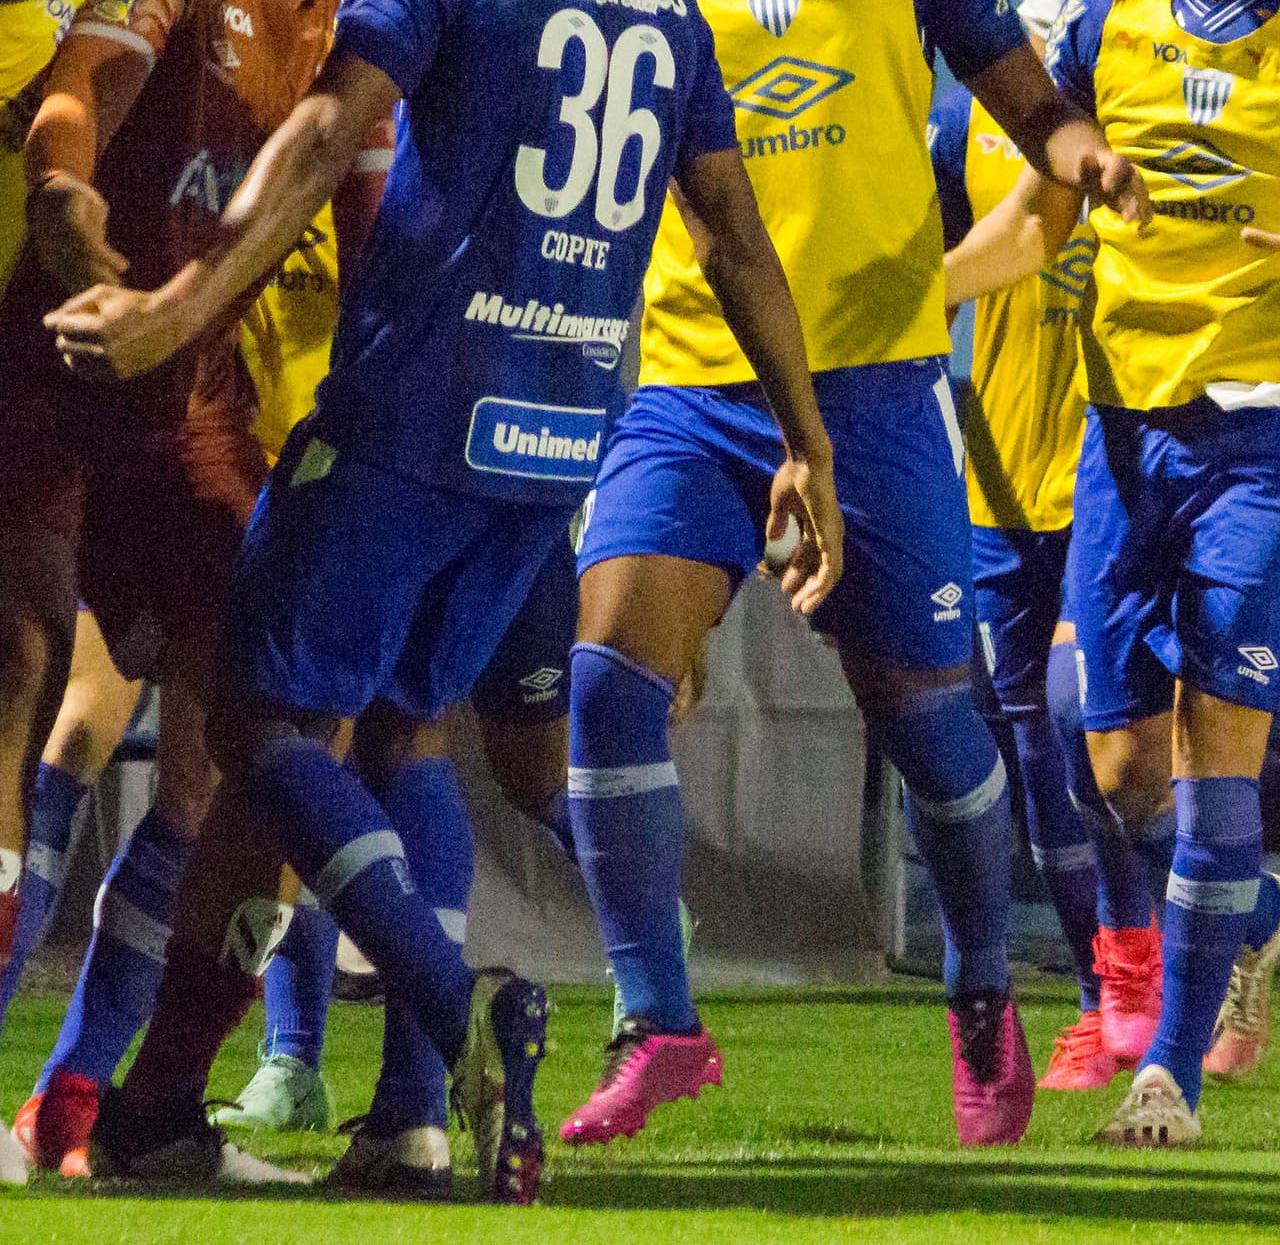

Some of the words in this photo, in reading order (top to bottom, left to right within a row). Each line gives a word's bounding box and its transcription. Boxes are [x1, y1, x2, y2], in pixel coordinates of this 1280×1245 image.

[1153, 41, 1188, 65] VOA
[515, 8, 676, 231] 36
[738, 123, 847, 159] umbro
[464, 290, 630, 343] Multimarcas
[493, 421, 601, 462] Unimed
